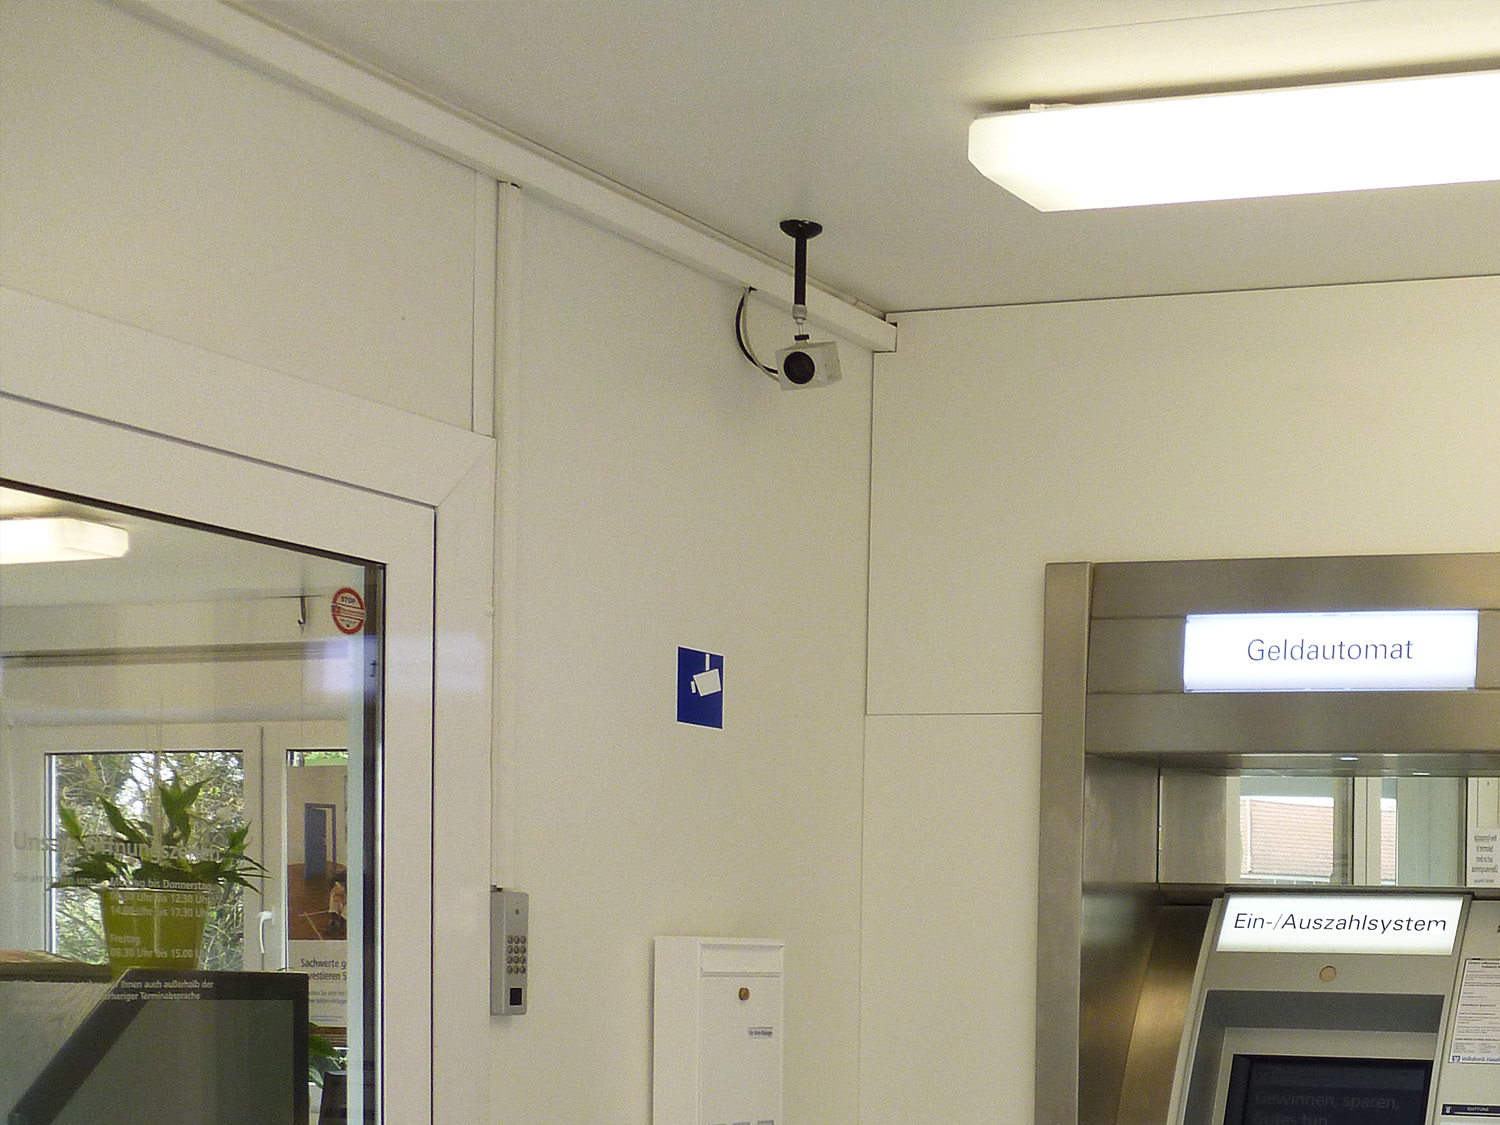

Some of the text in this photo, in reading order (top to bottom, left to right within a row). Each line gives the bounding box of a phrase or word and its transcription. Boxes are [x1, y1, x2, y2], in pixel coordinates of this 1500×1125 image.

[1246, 638, 1414, 662] Geldautomat
[1233, 911, 1447, 936] Ein-/Auszahlsystem
[301, 957, 339, 968] Sachwerte
[1343, 1096, 1401, 1111] sparen,
